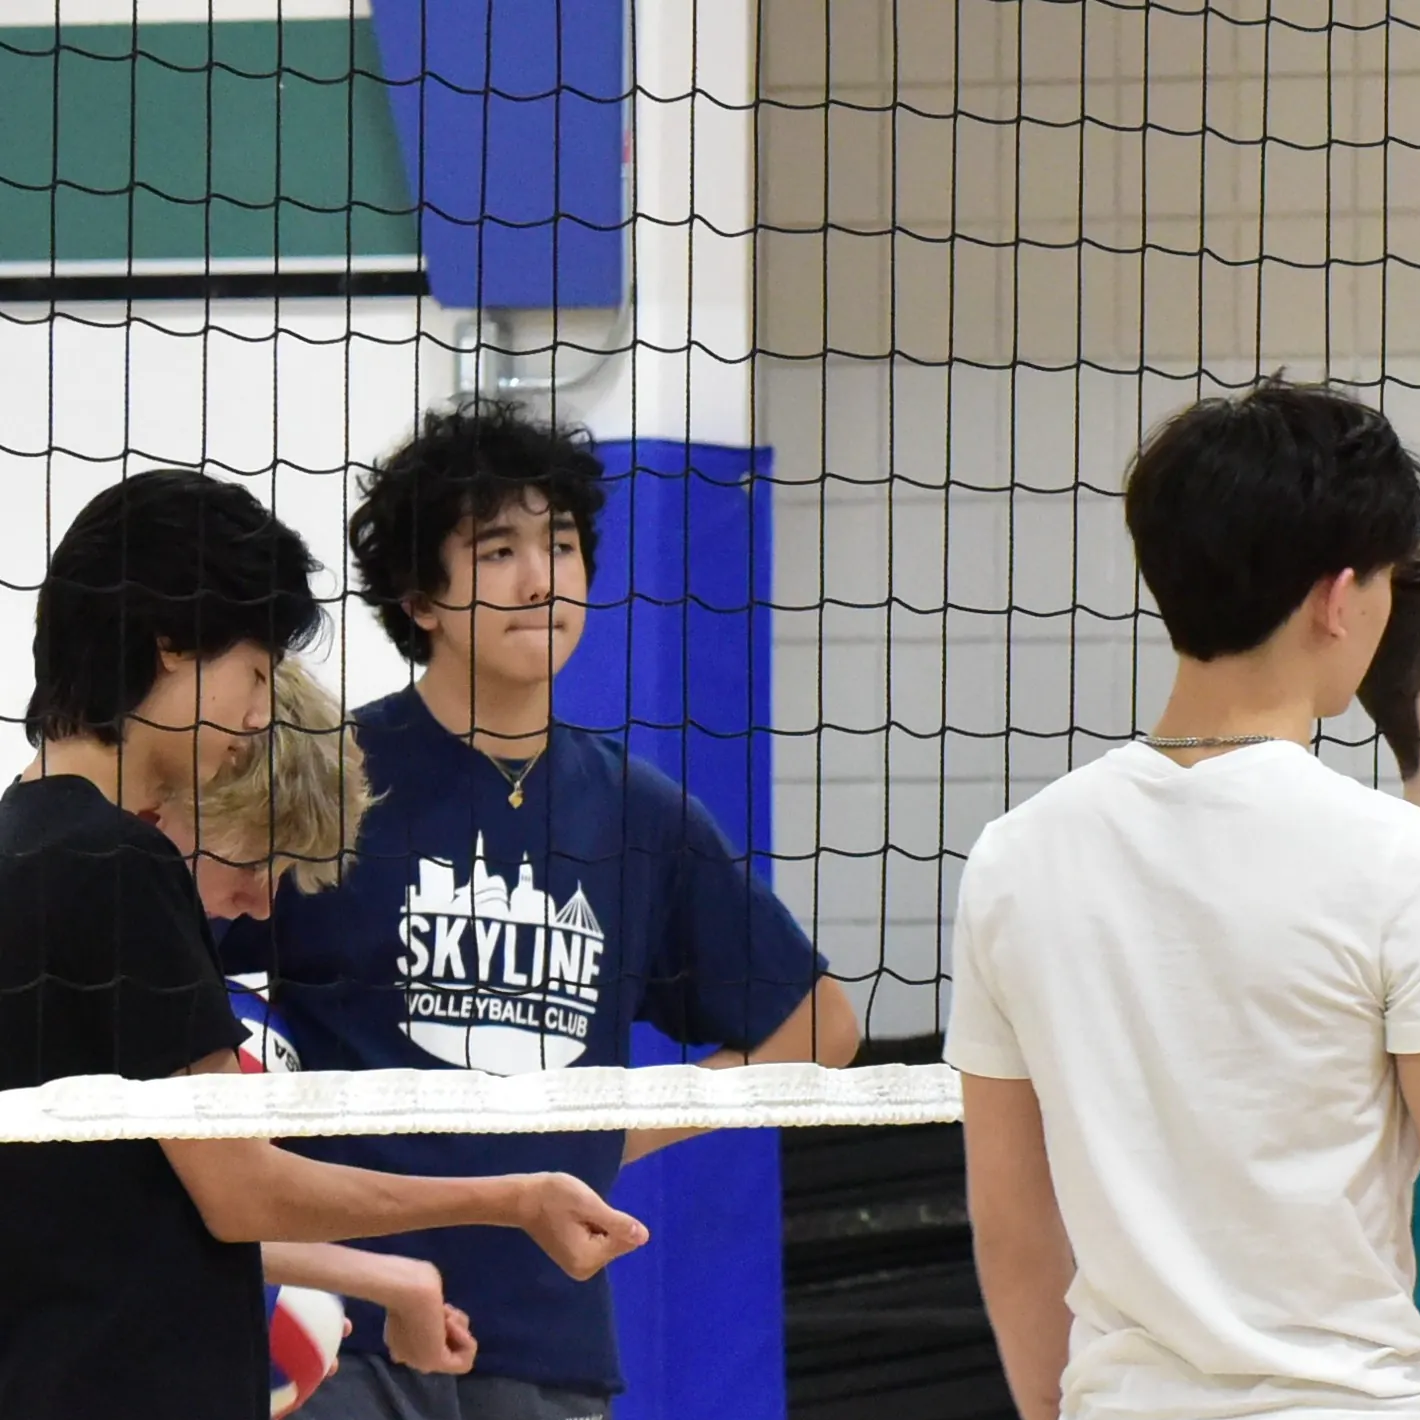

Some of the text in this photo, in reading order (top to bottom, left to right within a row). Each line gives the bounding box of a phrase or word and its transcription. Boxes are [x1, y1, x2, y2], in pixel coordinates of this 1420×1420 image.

[396, 914, 604, 1003] SKYLINE
[404, 992, 589, 1038] VOLLEYBALL CLUB
